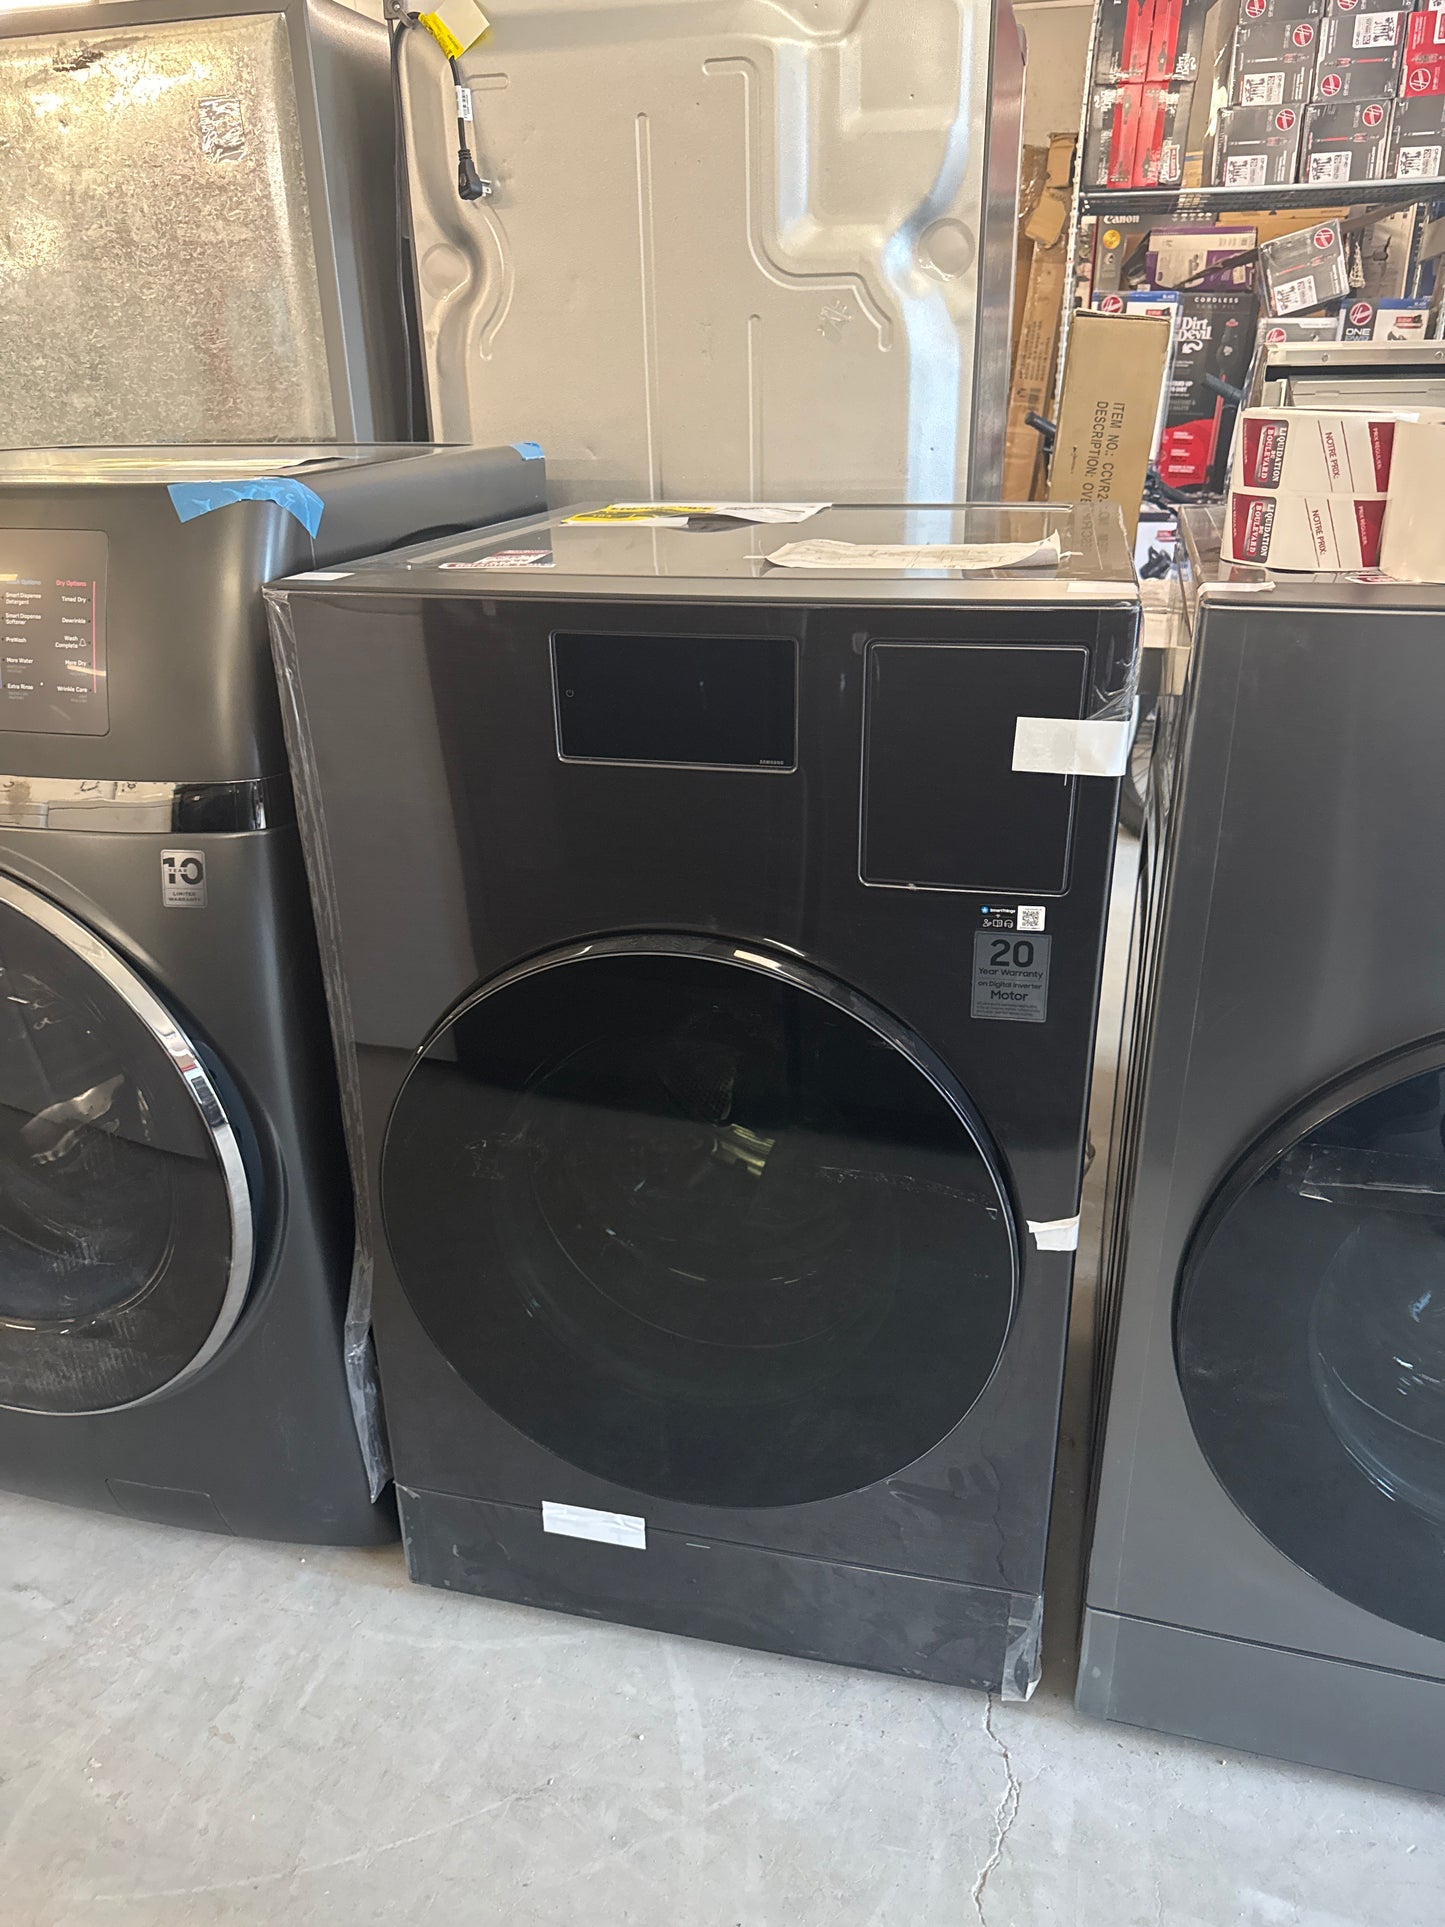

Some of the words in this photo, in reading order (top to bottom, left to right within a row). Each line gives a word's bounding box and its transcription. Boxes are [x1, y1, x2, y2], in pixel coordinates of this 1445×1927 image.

[1103, 215, 1140, 224] Canon
[1179, 326, 1212, 341] Devil
[1182, 316, 1208, 330] Dirt
[1346, 328, 1371, 336] ONE
[1110, 402, 1126, 429] ITEM
[1085, 401, 1109, 478] DESCRIPTION:
[1325, 431, 1337, 459] NOTRE
[1261, 429, 1275, 479] BOULEVARD
[1272, 427, 1287, 482] LIQUIDATION
[1329, 459, 1340, 480] PRIX:
[1248, 504, 1263, 553] BOULEVARD
[1260, 504, 1275, 556] LIQUIDATION
[1312, 510, 1323, 536] NOTRE
[1316, 536, 1327, 555] PRIX:
[162, 857, 204, 885] 10
[990, 939, 1034, 968] 20
[979, 967, 999, 975] Year
[1001, 968, 1043, 980] Warranty
[989, 980, 1012, 989] Digital
[990, 990, 1028, 1001] Motor
